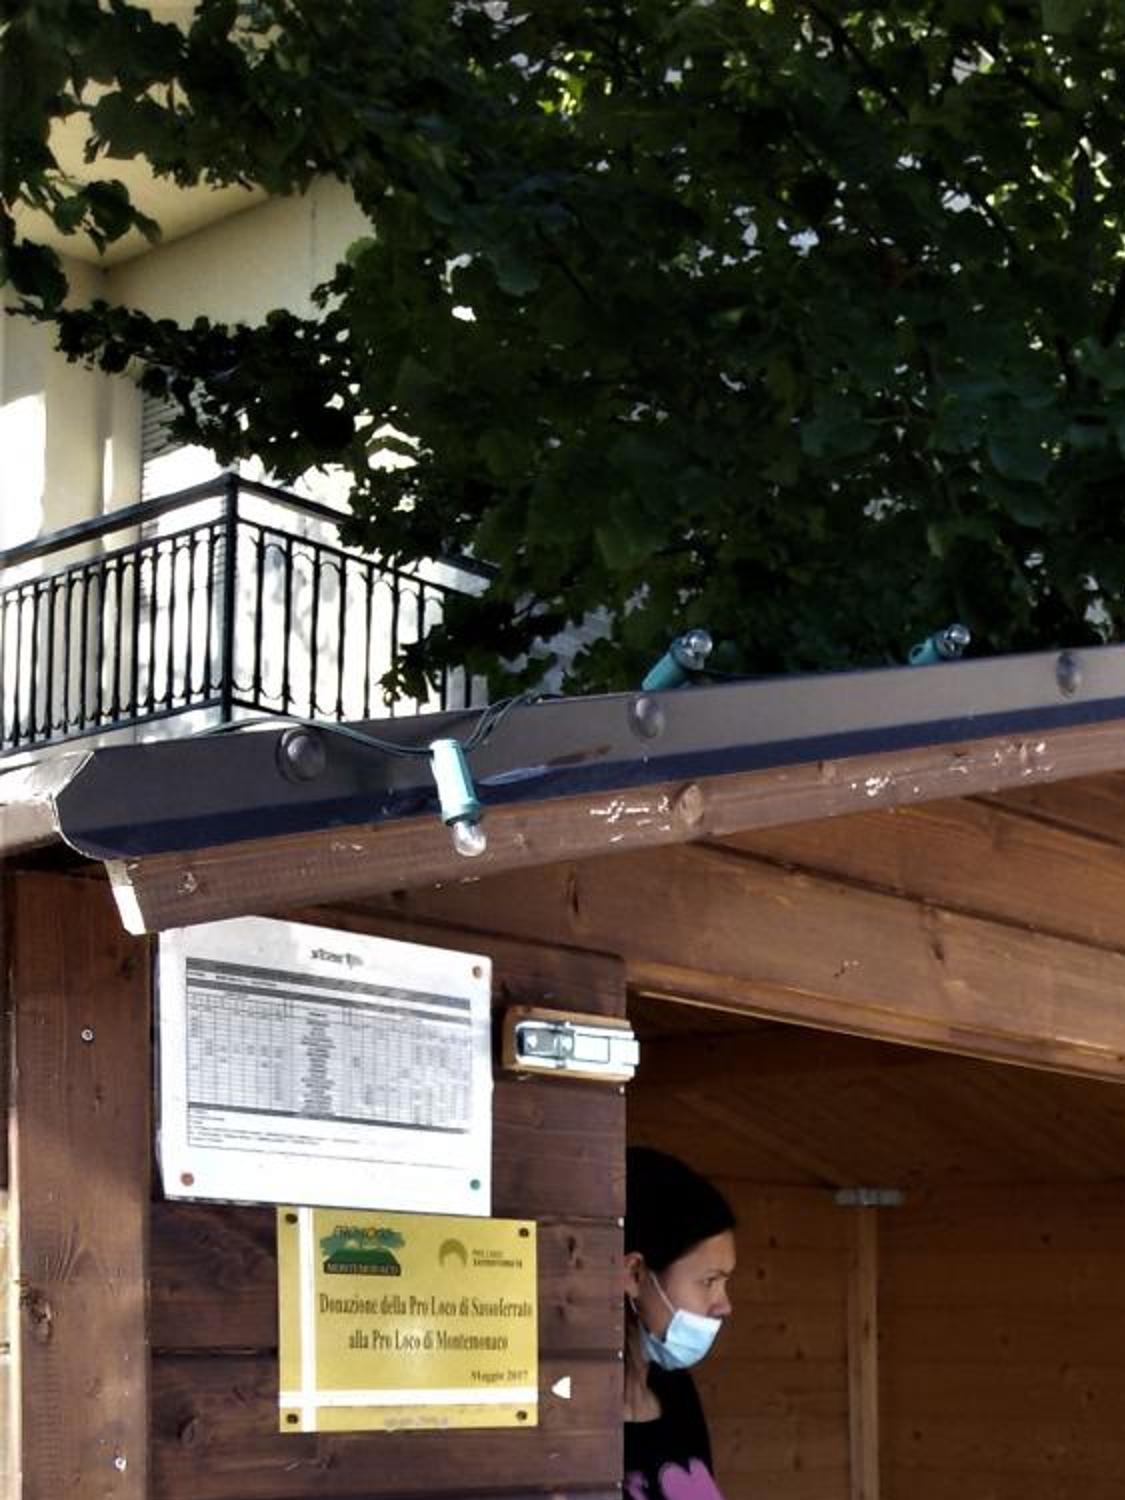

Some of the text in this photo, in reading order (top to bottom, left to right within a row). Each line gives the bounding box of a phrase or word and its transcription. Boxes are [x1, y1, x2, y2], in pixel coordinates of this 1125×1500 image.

[319, 1293, 532, 1318] Donazione della Pro Loco di Sassoferrato
[349, 1329, 509, 1351] alla Pro Loco di Montemonaco
[471, 1370, 504, 1383] Maggio
